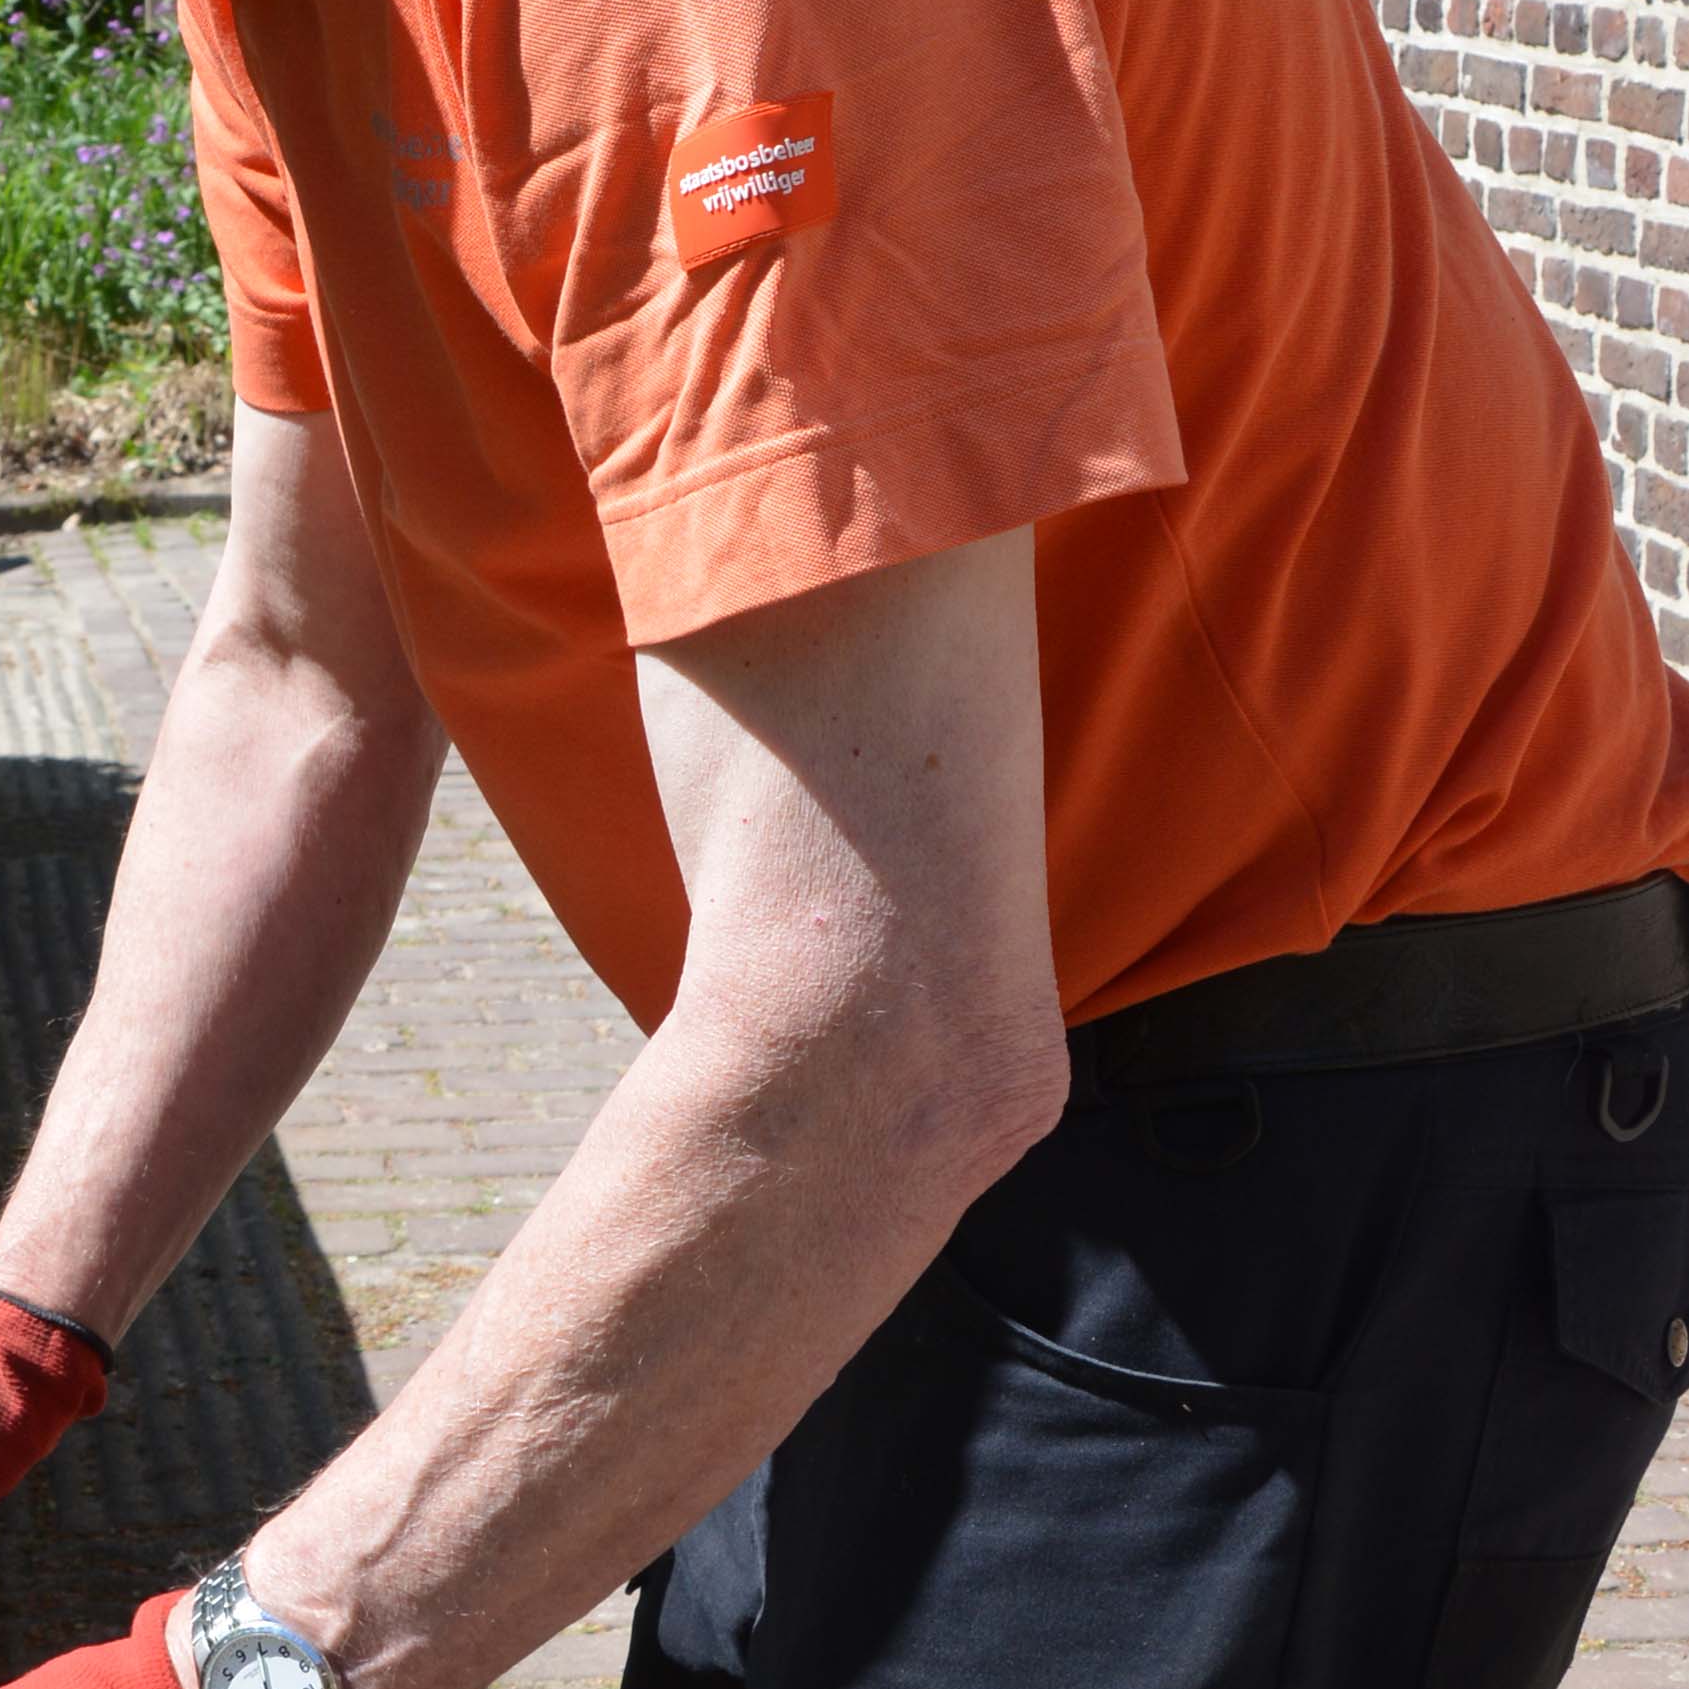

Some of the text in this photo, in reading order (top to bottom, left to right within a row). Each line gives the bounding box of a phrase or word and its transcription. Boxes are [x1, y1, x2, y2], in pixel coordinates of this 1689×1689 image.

[678, 135, 816, 195] staatsbosbeheer
[701, 167, 806, 213] vrijwilliger
[235, 1648, 248, 1663] 6
[257, 1641, 268, 1656] 7
[279, 1645, 291, 1658] 8
[222, 1666, 234, 1682] 5
[298, 1659, 311, 1674] 9
